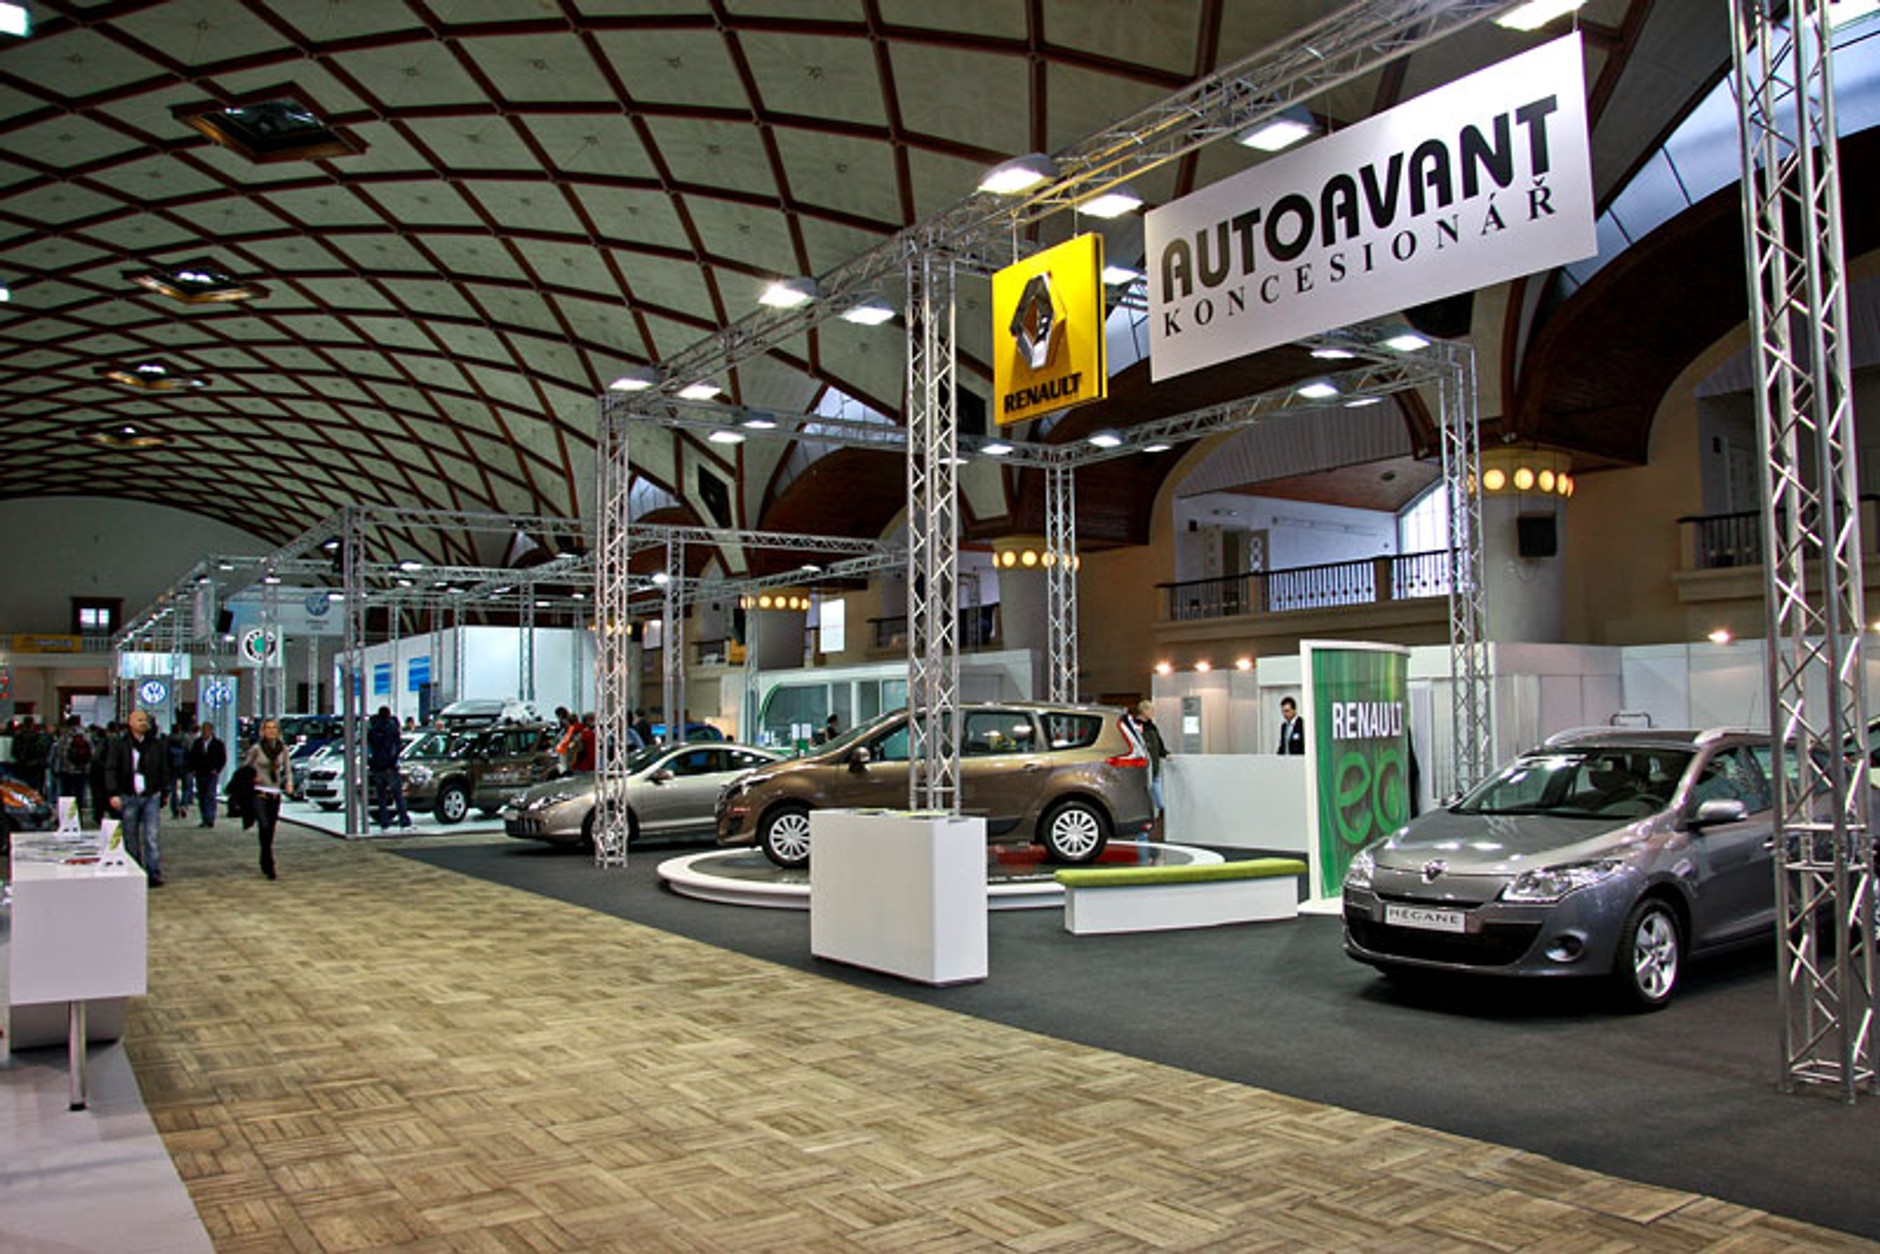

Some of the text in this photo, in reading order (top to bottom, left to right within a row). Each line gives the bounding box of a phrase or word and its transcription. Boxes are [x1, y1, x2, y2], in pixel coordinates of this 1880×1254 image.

[1162, 94, 1558, 304] AUTOAVANT
[1163, 175, 1557, 338] KONCESIONÁŘ
[1004, 372, 1082, 414] RENAULT
[1332, 701, 1403, 739] RENAULT
